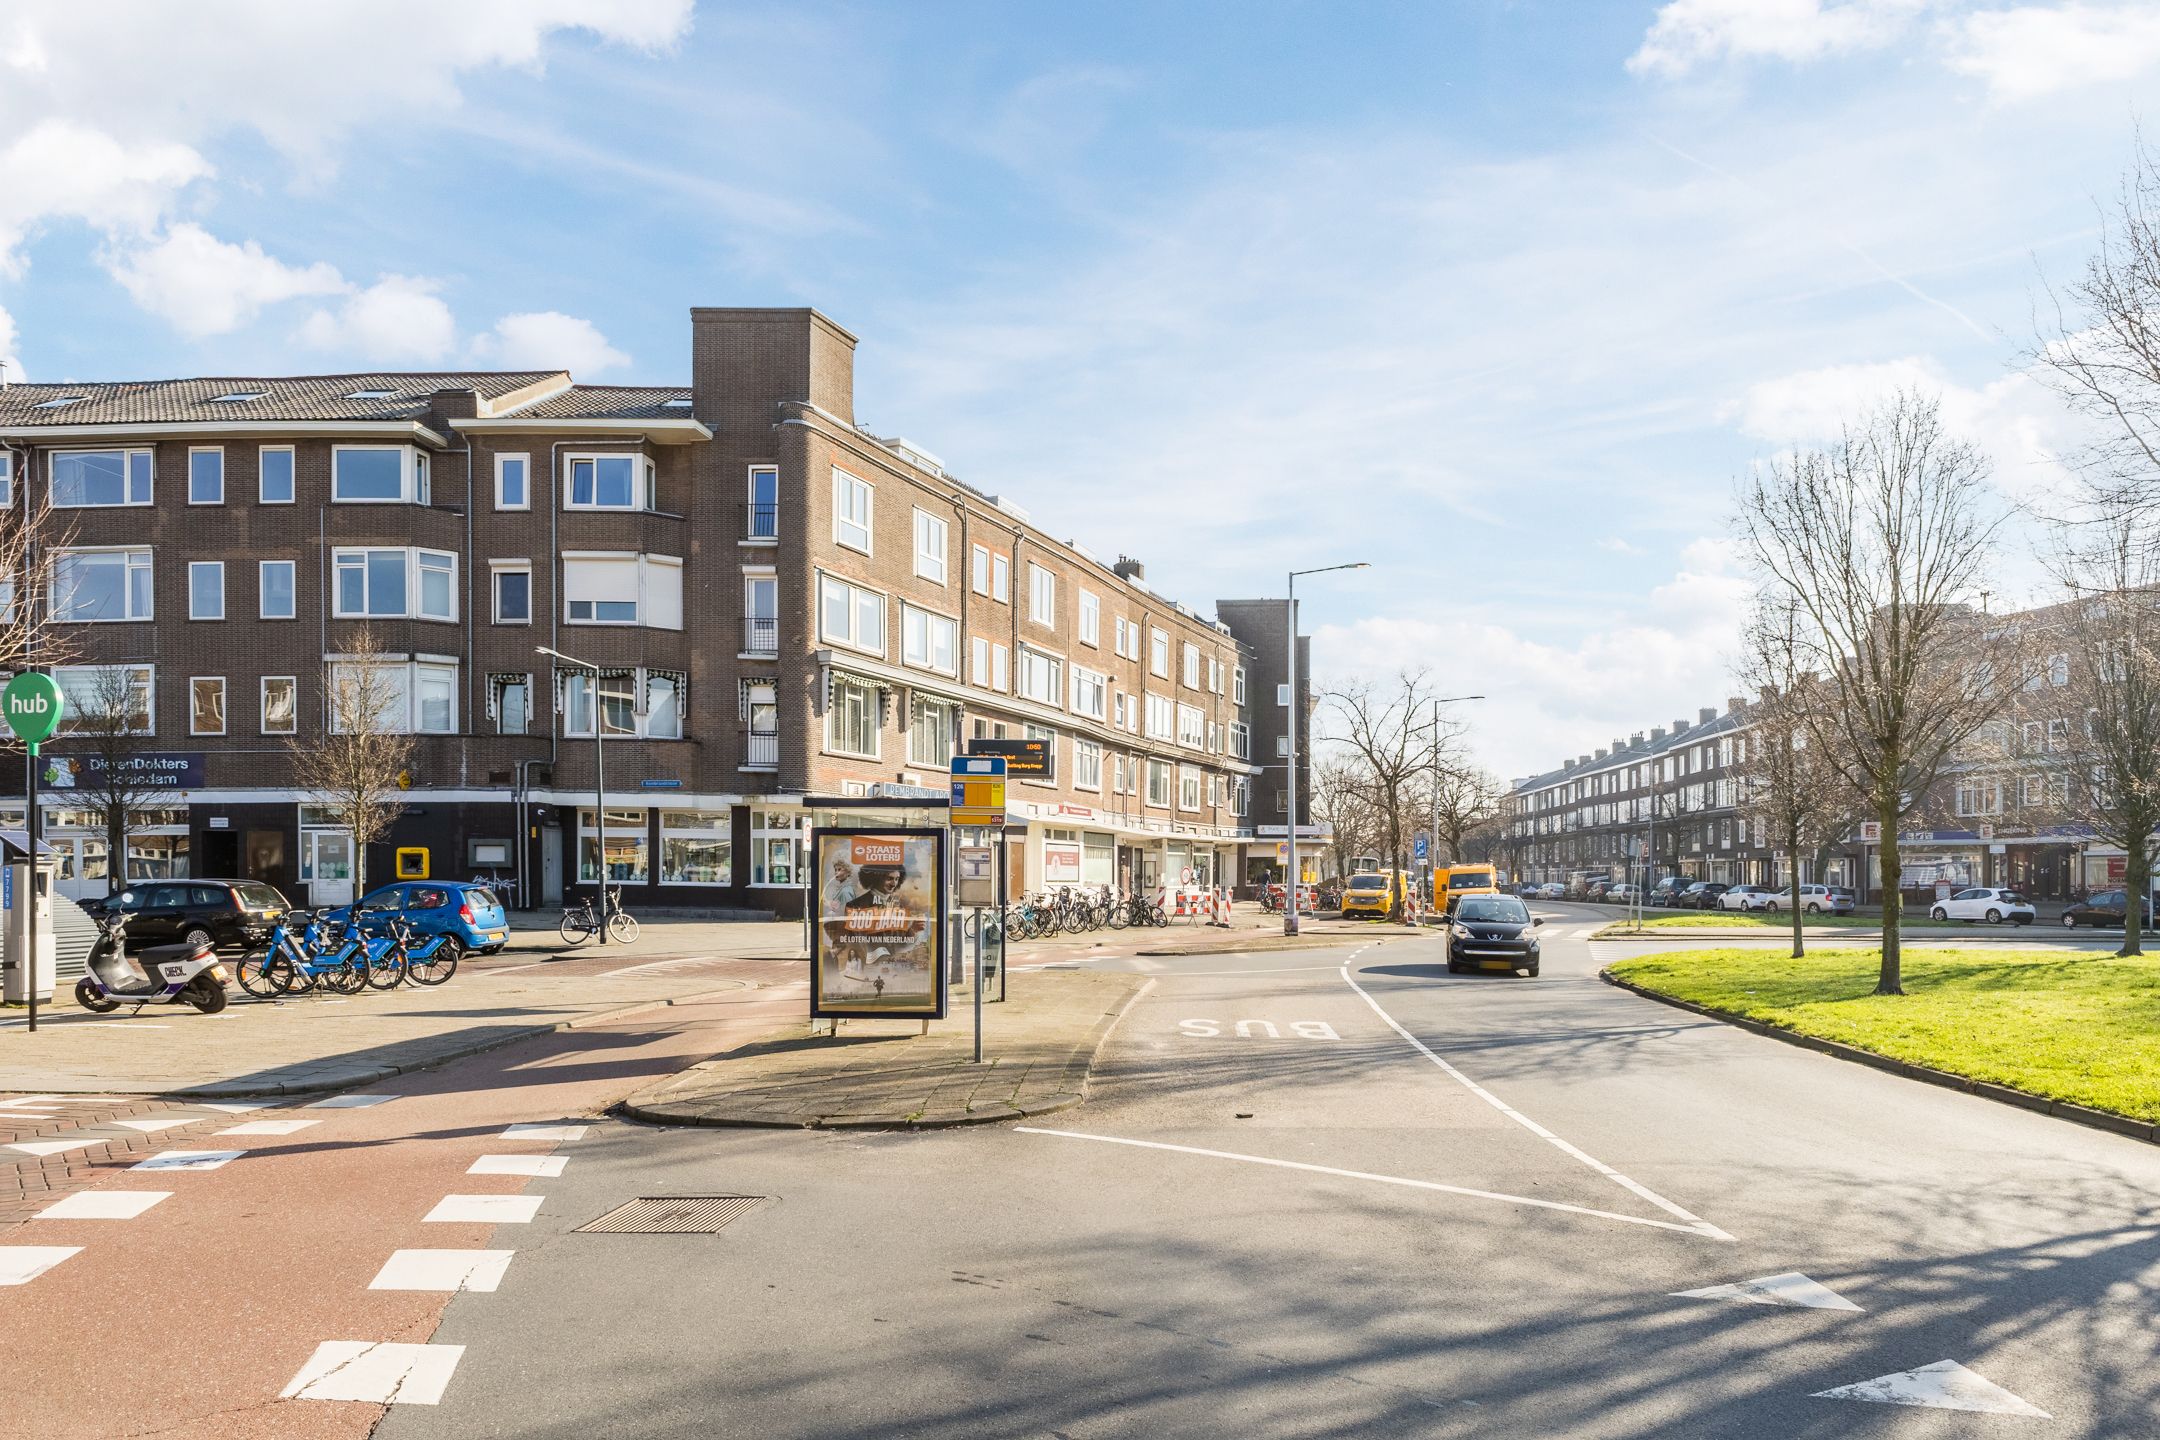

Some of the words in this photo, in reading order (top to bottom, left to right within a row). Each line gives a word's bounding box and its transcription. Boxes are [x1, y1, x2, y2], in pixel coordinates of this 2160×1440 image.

[11, 692, 48, 714] hub
[890, 784, 932, 798] REMBRANDT
[865, 845, 901, 854] STAATS
[865, 853, 901, 862] LOTERIJ
[872, 895, 882, 905] AL
[874, 908, 906, 930] JAAR
[848, 935, 871, 943] LOTERIJ
[871, 935, 883, 943] VAN
[883, 935, 915, 944] NEDERLAND
[1178, 1018, 1342, 1041] BUS
